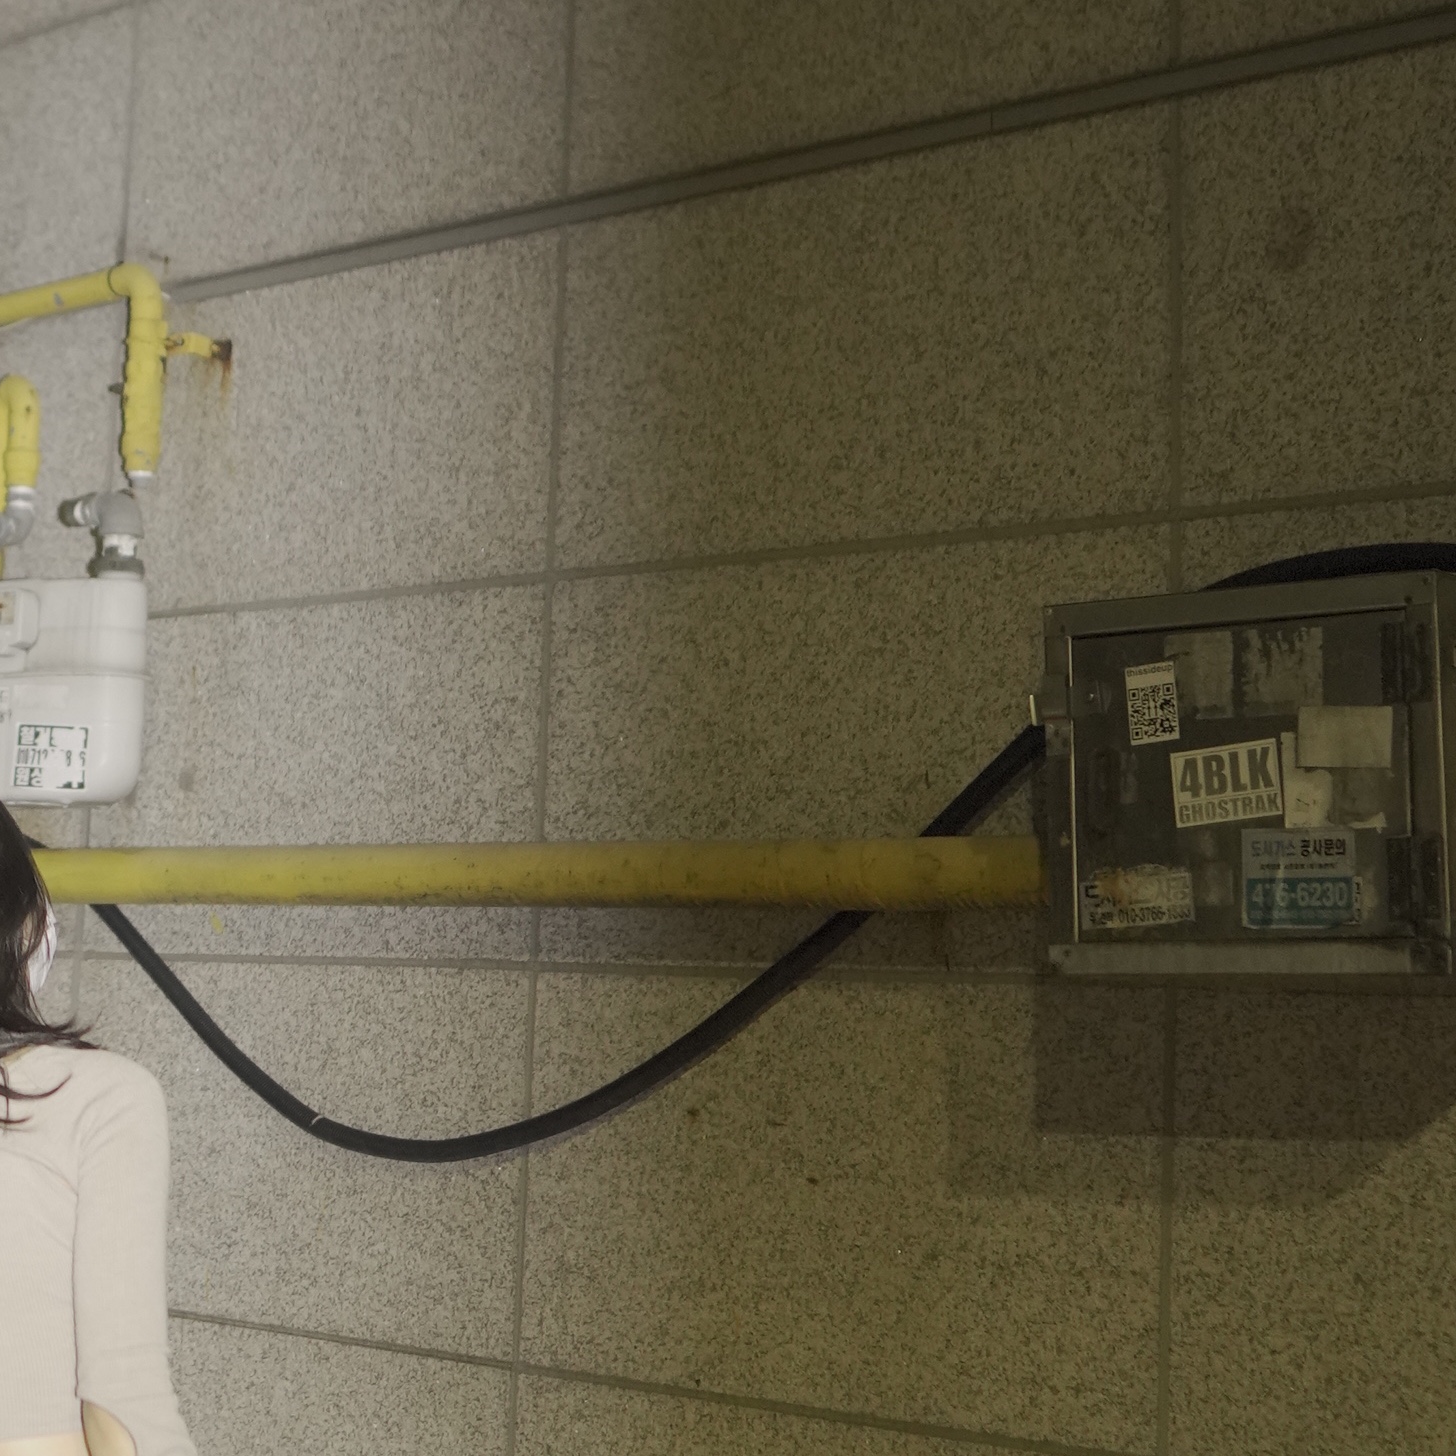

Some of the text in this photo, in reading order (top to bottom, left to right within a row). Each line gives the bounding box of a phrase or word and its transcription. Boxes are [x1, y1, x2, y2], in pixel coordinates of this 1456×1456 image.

[1127, 664, 1174, 678] thissideup
[1180, 746, 1275, 799] 4BLK
[1179, 791, 1281, 824] GHOSTRAK
[1300, 838, 1346, 857] 공사문의
